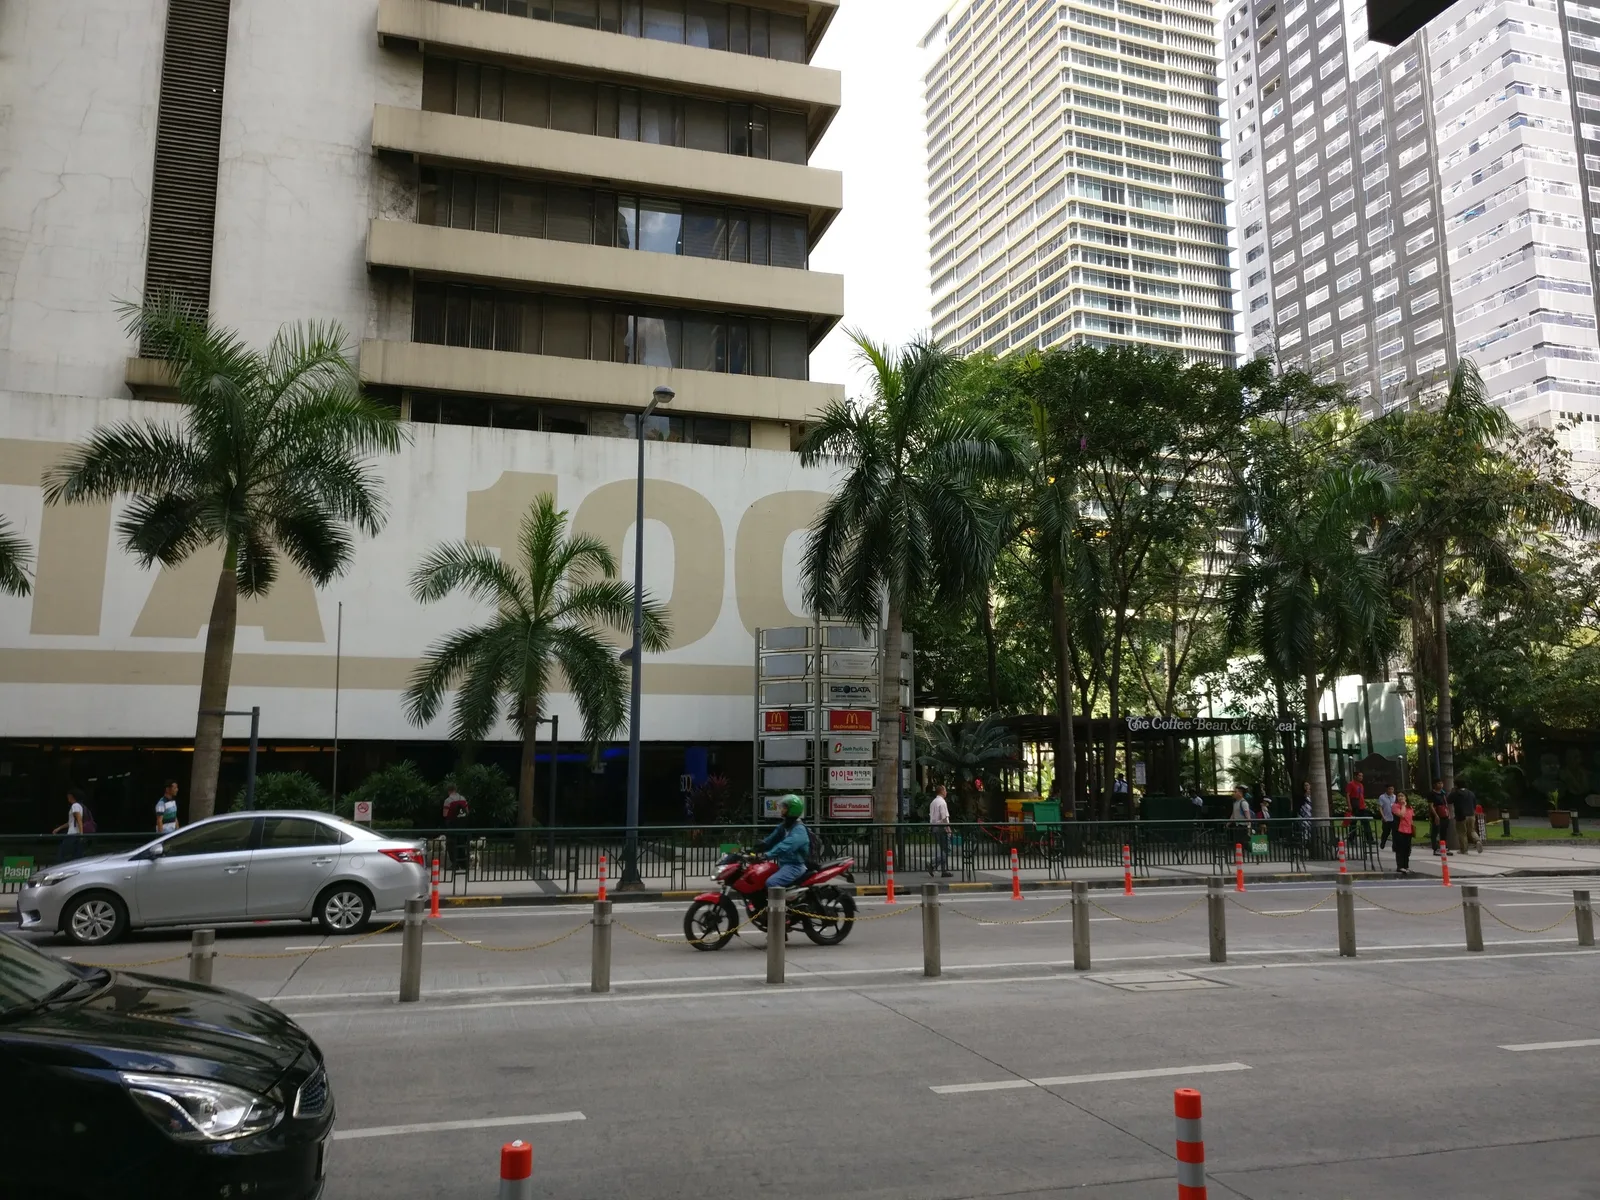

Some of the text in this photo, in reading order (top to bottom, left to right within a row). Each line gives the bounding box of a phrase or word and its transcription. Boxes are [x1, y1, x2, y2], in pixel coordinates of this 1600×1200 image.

[830, 685, 871, 693] GEODATA
[1125, 715, 1150, 732] The
[1151, 715, 1191, 731] Coffee
[1191, 717, 1229, 732] Bean
[1230, 718, 1242, 731] &
[3, 865, 31, 879] Pasig
